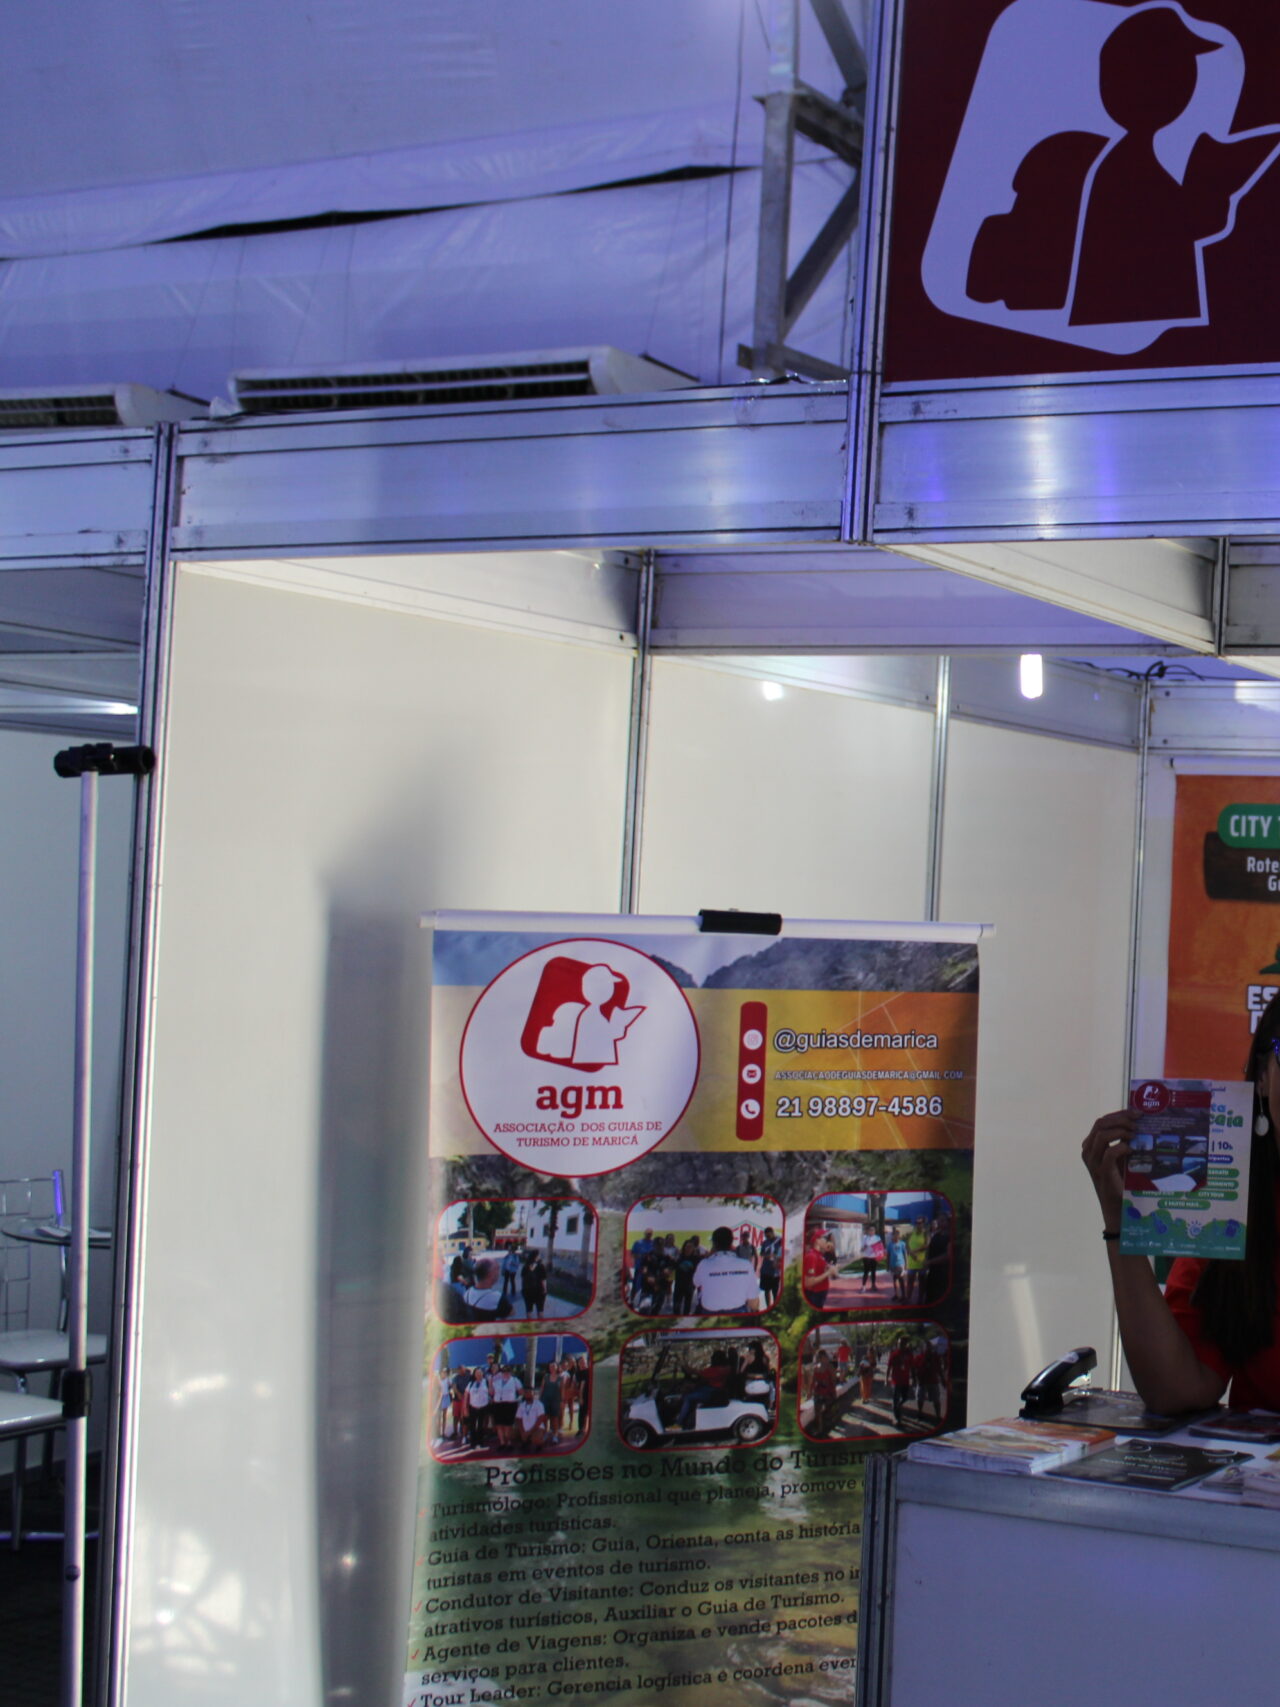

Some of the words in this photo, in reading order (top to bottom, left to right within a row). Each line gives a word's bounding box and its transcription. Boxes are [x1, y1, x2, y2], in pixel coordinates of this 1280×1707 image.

[1230, 815, 1272, 838] CITY
[774, 1029, 938, 1054] @guiasdemarica
[536, 1084, 624, 1119] agm
[777, 1095, 803, 1118] 21
[809, 1094, 944, 1118] 98897-4586
[494, 1121, 575, 1135] ASSOCIAÇÃO
[581, 1122, 605, 1132] DOS
[607, 1121, 644, 1132] GUIAS
[646, 1120, 663, 1131] DE
[516, 1136, 570, 1148] TURISMO
[573, 1136, 589, 1147] DE
[592, 1134, 639, 1147] MARICÁ
[485, 1463, 614, 1487] Profissões
[622, 1464, 652, 1479] no
[660, 1456, 746, 1477] Mundo
[753, 1453, 784, 1471] do
[431, 1496, 551, 1519] Turismólogo:
[557, 1488, 660, 1508] Profissional
[667, 1490, 700, 1506] que
[707, 1484, 776, 1504] planeja,
[780, 1479, 857, 1499] promove
[428, 1547, 470, 1566] Guia
[475, 1544, 499, 1560] de
[505, 1540, 586, 1558] Turismo:
[592, 1536, 640, 1555] Guia,
[646, 1533, 718, 1551] Orienta,
[724, 1529, 771, 1546] conta
[776, 1527, 794, 1540] as
[798, 1521, 861, 1540] história
[431, 1520, 526, 1541] atividades
[426, 1570, 493, 1591] turistas
[497, 1568, 526, 1583] em
[531, 1562, 604, 1581] eventos
[609, 1558, 634, 1575] de
[639, 1558, 711, 1575] turismo.
[426, 1593, 513, 1614] Condutor
[518, 1588, 543, 1605] de
[548, 1584, 634, 1604] Visitante:
[640, 1579, 710, 1598] Conduz
[714, 1579, 734, 1592] os
[738, 1570, 819, 1590] visitantes
[823, 1568, 845, 1582] no
[424, 1617, 504, 1638] atrativos
[510, 1610, 598, 1630] turísticos,
[603, 1602, 676, 1622] Auxiliar
[682, 1606, 693, 1618] o
[697, 1599, 739, 1617] Guia
[743, 1596, 766, 1613] de
[770, 1591, 845, 1609] Turismo.
[423, 1642, 491, 1663] Agente
[496, 1637, 521, 1653] de
[526, 1631, 607, 1652] Viagens:
[613, 1628, 695, 1649] Organiza
[701, 1627, 712, 1639] e
[717, 1619, 771, 1638] vende
[776, 1613, 842, 1636] pacotes
[420, 1689, 465, 1707] Tour
[469, 1685, 541, 1704] Leader:
[546, 1677, 632, 1697] Gerencia
[637, 1673, 713, 1694] logística
[717, 1670, 728, 1683] e
[732, 1660, 815, 1681] coordena
[421, 1666, 500, 1688] serviços
[505, 1662, 547, 1681] para
[552, 1654, 629, 1673] clientes.
